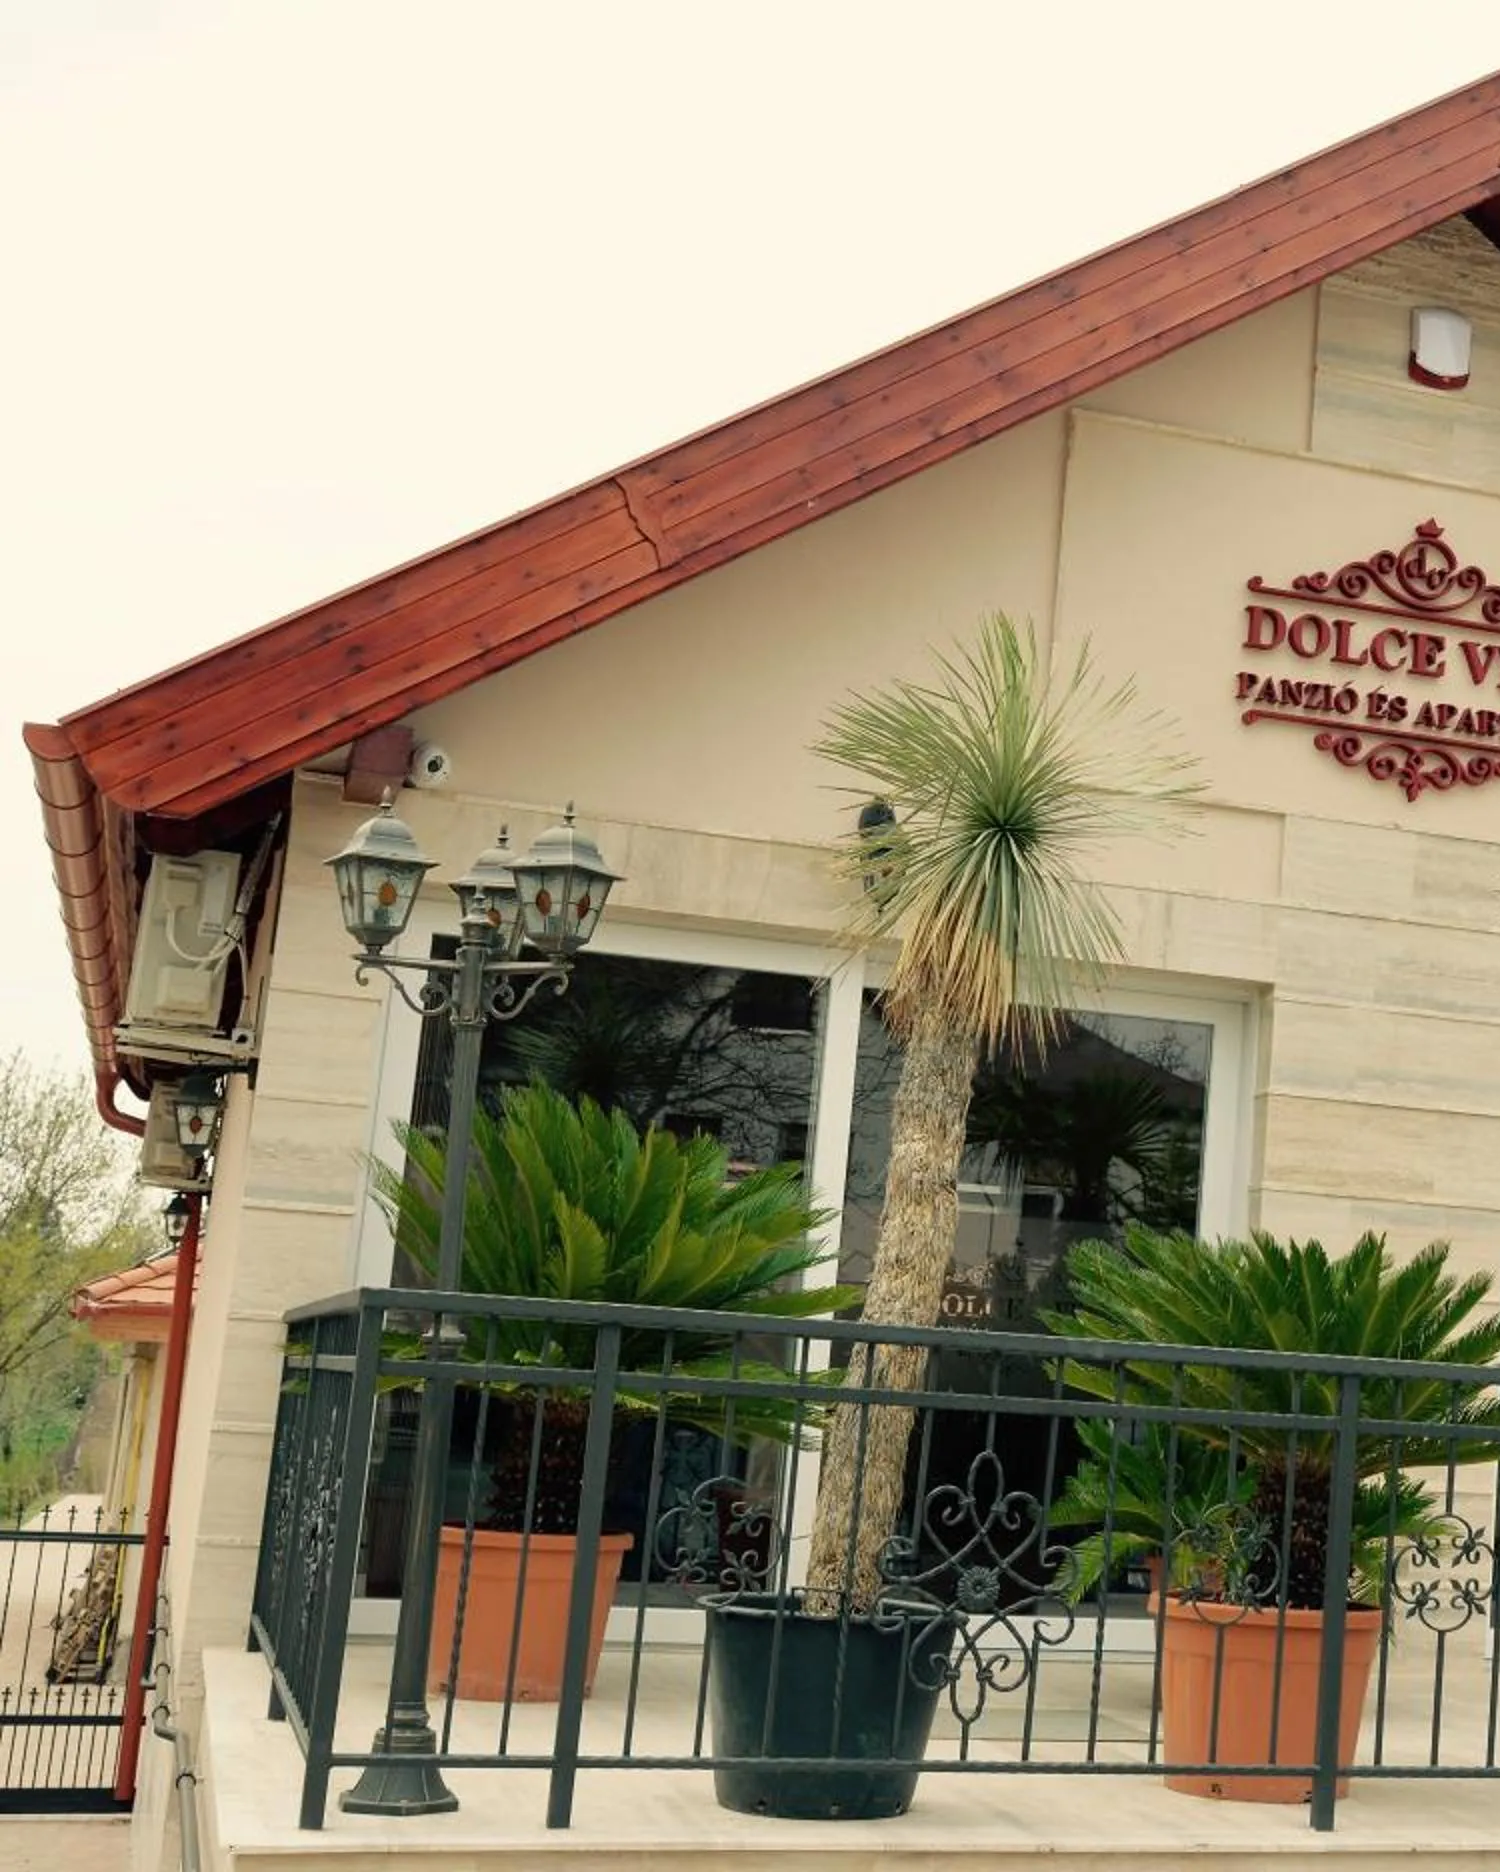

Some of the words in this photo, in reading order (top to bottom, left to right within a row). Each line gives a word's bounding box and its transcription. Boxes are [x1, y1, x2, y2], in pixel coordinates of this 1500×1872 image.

[1242, 605, 1447, 678] DOLCE
[1235, 672, 1358, 714] PANZIÓ
[1366, 686, 1409, 722] ÉS
